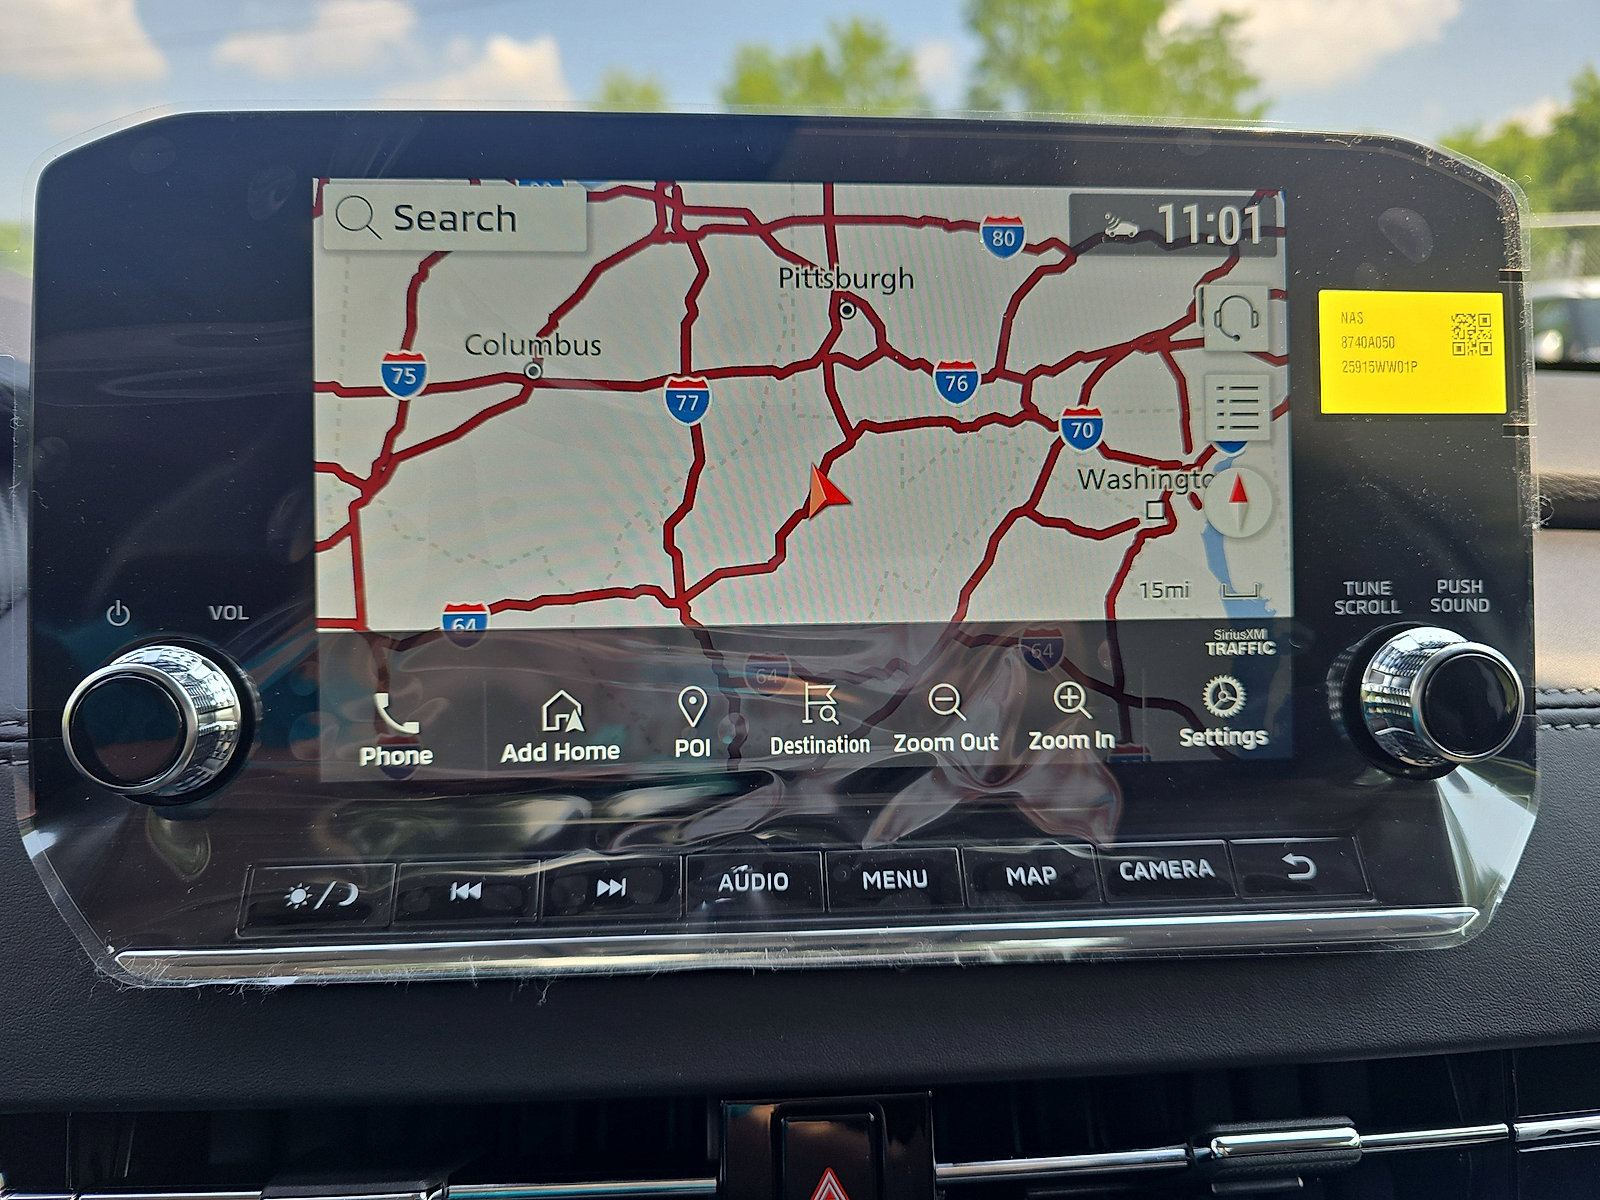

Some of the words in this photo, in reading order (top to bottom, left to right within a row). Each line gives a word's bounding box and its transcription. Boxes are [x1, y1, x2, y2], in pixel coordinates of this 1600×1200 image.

[394, 203, 517, 233] Search
[1158, 203, 1263, 246] 11:01
[993, 229, 1016, 247] 80
[778, 266, 915, 295] Pittsburgh
[1341, 311, 1364, 325] NAS
[465, 333, 602, 358] Columbus
[1341, 335, 1396, 349] 8740A050
[1342, 360, 1418, 374] 25915WW01P
[390, 367, 418, 386] 75
[945, 374, 968, 393] 76
[674, 394, 700, 412] 77
[1071, 421, 1094, 439] 70
[1139, 581, 1190, 599] 15mi
[1343, 579, 1393, 596] TUNE
[1436, 579, 1483, 594] PUSH
[208, 605, 250, 621] VOL
[1334, 599, 1401, 615] SCROLL
[1430, 598, 1491, 613] SOUND
[452, 617, 477, 635] 64
[1213, 628, 1269, 641] SiriusXM
[1031, 643, 1054, 658] 64
[1205, 641, 1277, 657] TRAFFIC
[756, 668, 778, 684] 64
[674, 738, 712, 758] POI
[770, 734, 871, 756] Destination
[893, 734, 954, 753] Zoom
[959, 732, 1000, 752] Out
[1028, 731, 1090, 751] Zoom
[1094, 730, 1116, 750] In
[1179, 726, 1270, 752] Settings
[360, 746, 434, 767] Phone
[501, 741, 548, 763] Add
[554, 741, 621, 762] Home
[862, 868, 928, 890] MENU
[1006, 864, 1058, 886] MAP
[1119, 858, 1216, 882] CAMERA
[718, 869, 789, 893] AUDIO
